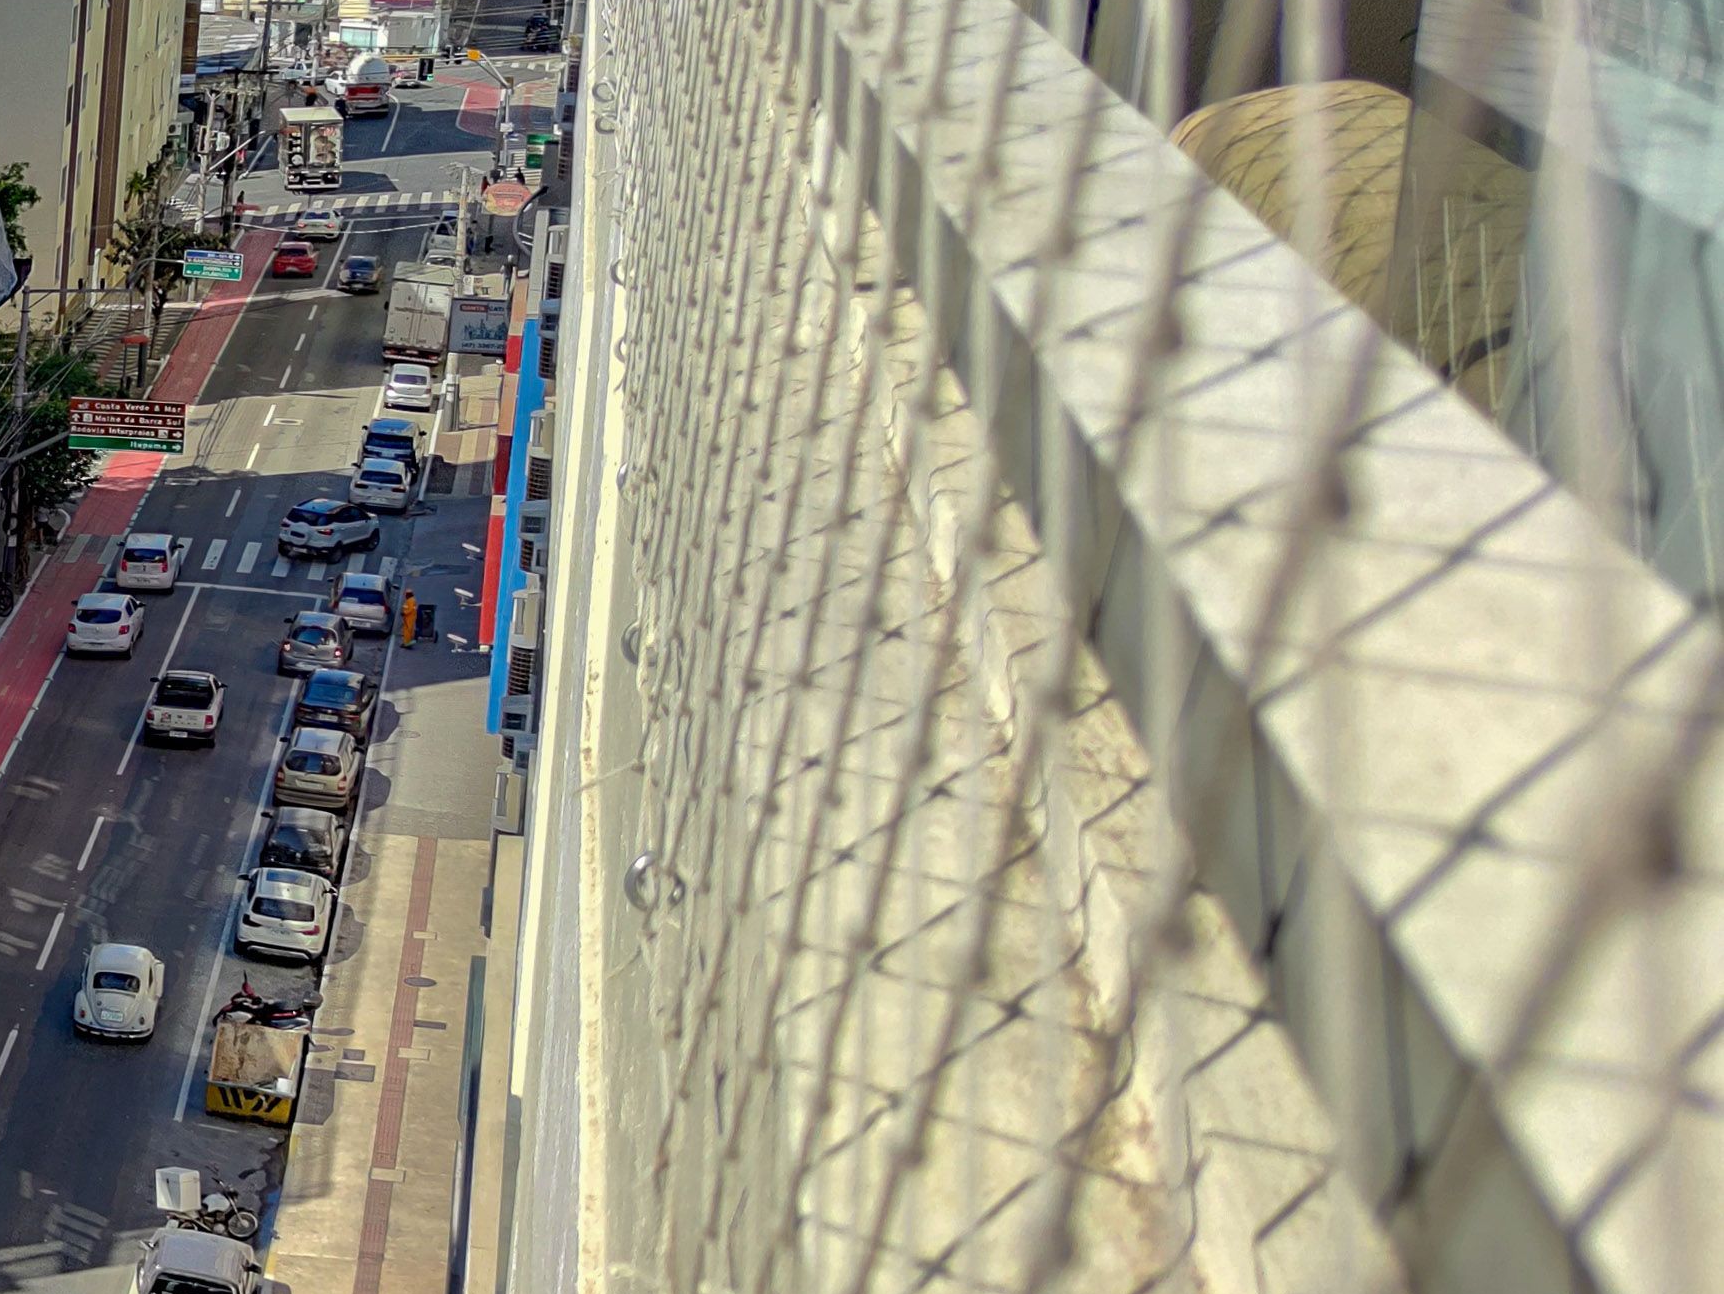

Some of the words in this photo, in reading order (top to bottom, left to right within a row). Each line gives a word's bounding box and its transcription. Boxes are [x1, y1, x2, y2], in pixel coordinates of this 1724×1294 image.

[94, 402, 120, 410] Costa
[125, 403, 150, 411] Verde
[164, 405, 182, 413] Mar
[124, 415, 135, 423] da
[139, 417, 163, 425] Barra
[166, 418, 182, 426] Sul
[71, 425, 105, 435] Rodovia
[108, 427, 155, 437] Interpraias
